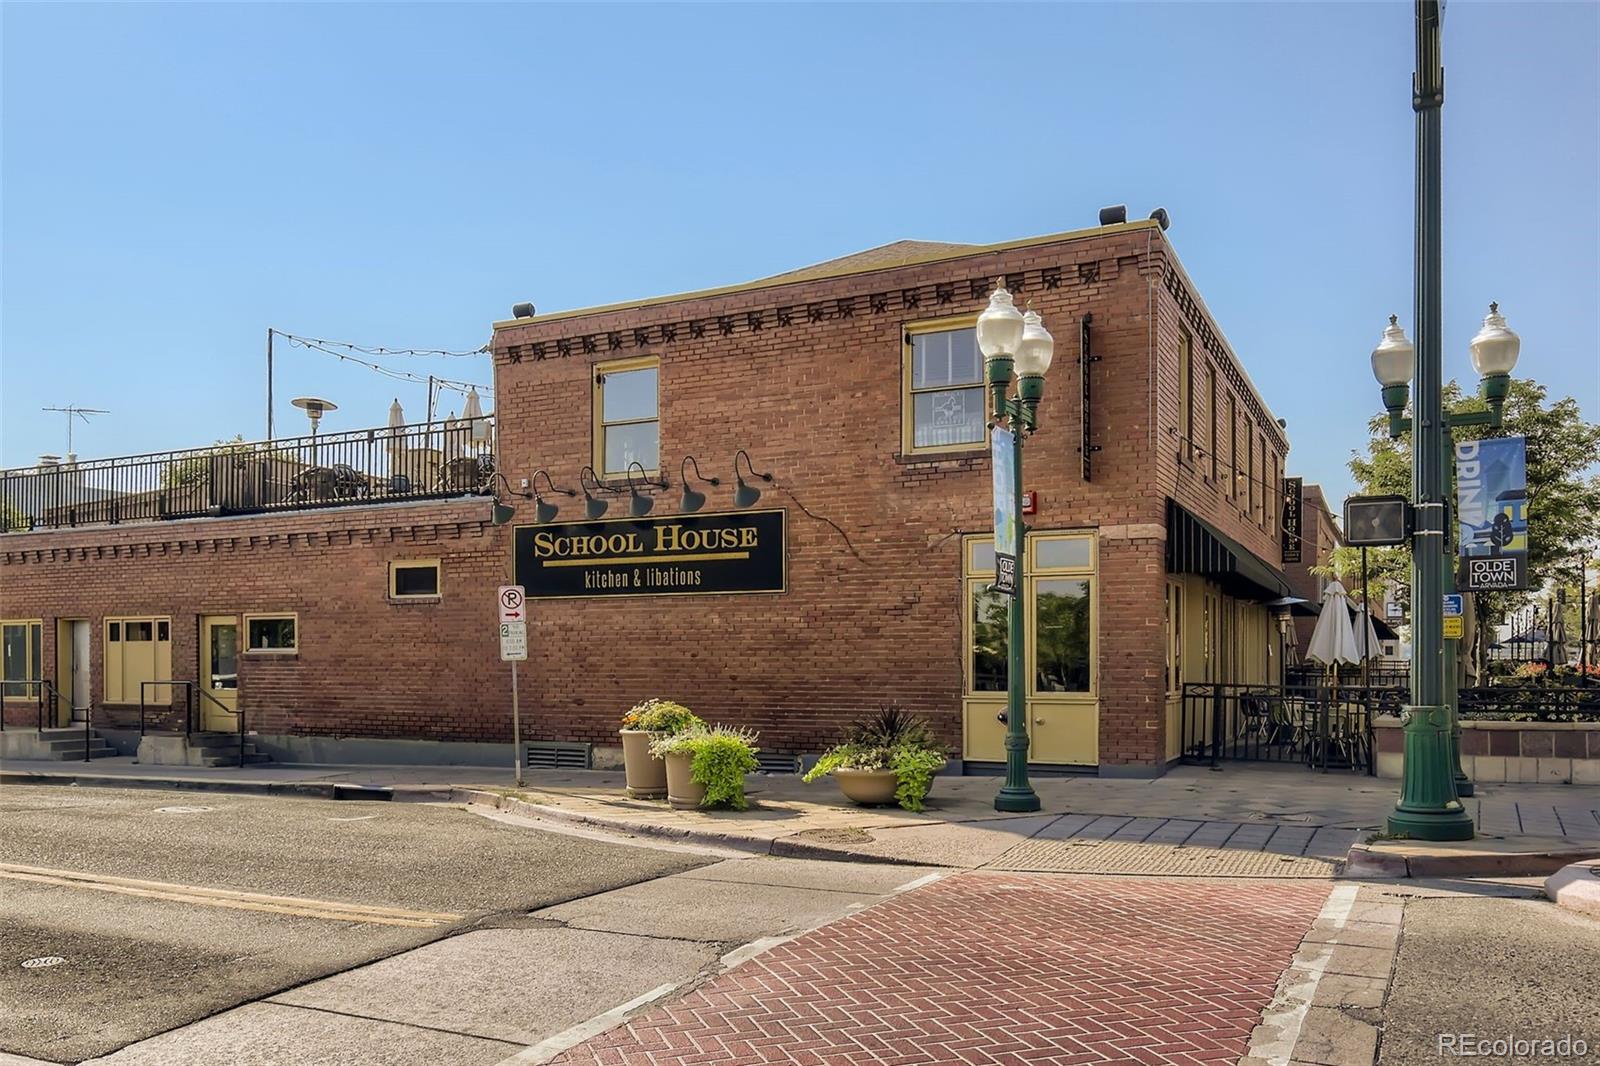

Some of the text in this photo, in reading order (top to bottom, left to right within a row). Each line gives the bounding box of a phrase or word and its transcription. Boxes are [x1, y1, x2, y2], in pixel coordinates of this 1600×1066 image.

[1456, 441, 1485, 528] DRINK
[534, 525, 758, 557] SCHOOL HOUSE
[1474, 560, 1511, 572] OLDE
[585, 567, 701, 588] kitchen & libations
[1472, 571, 1514, 583] TOWN
[501, 625, 508, 636] 2
